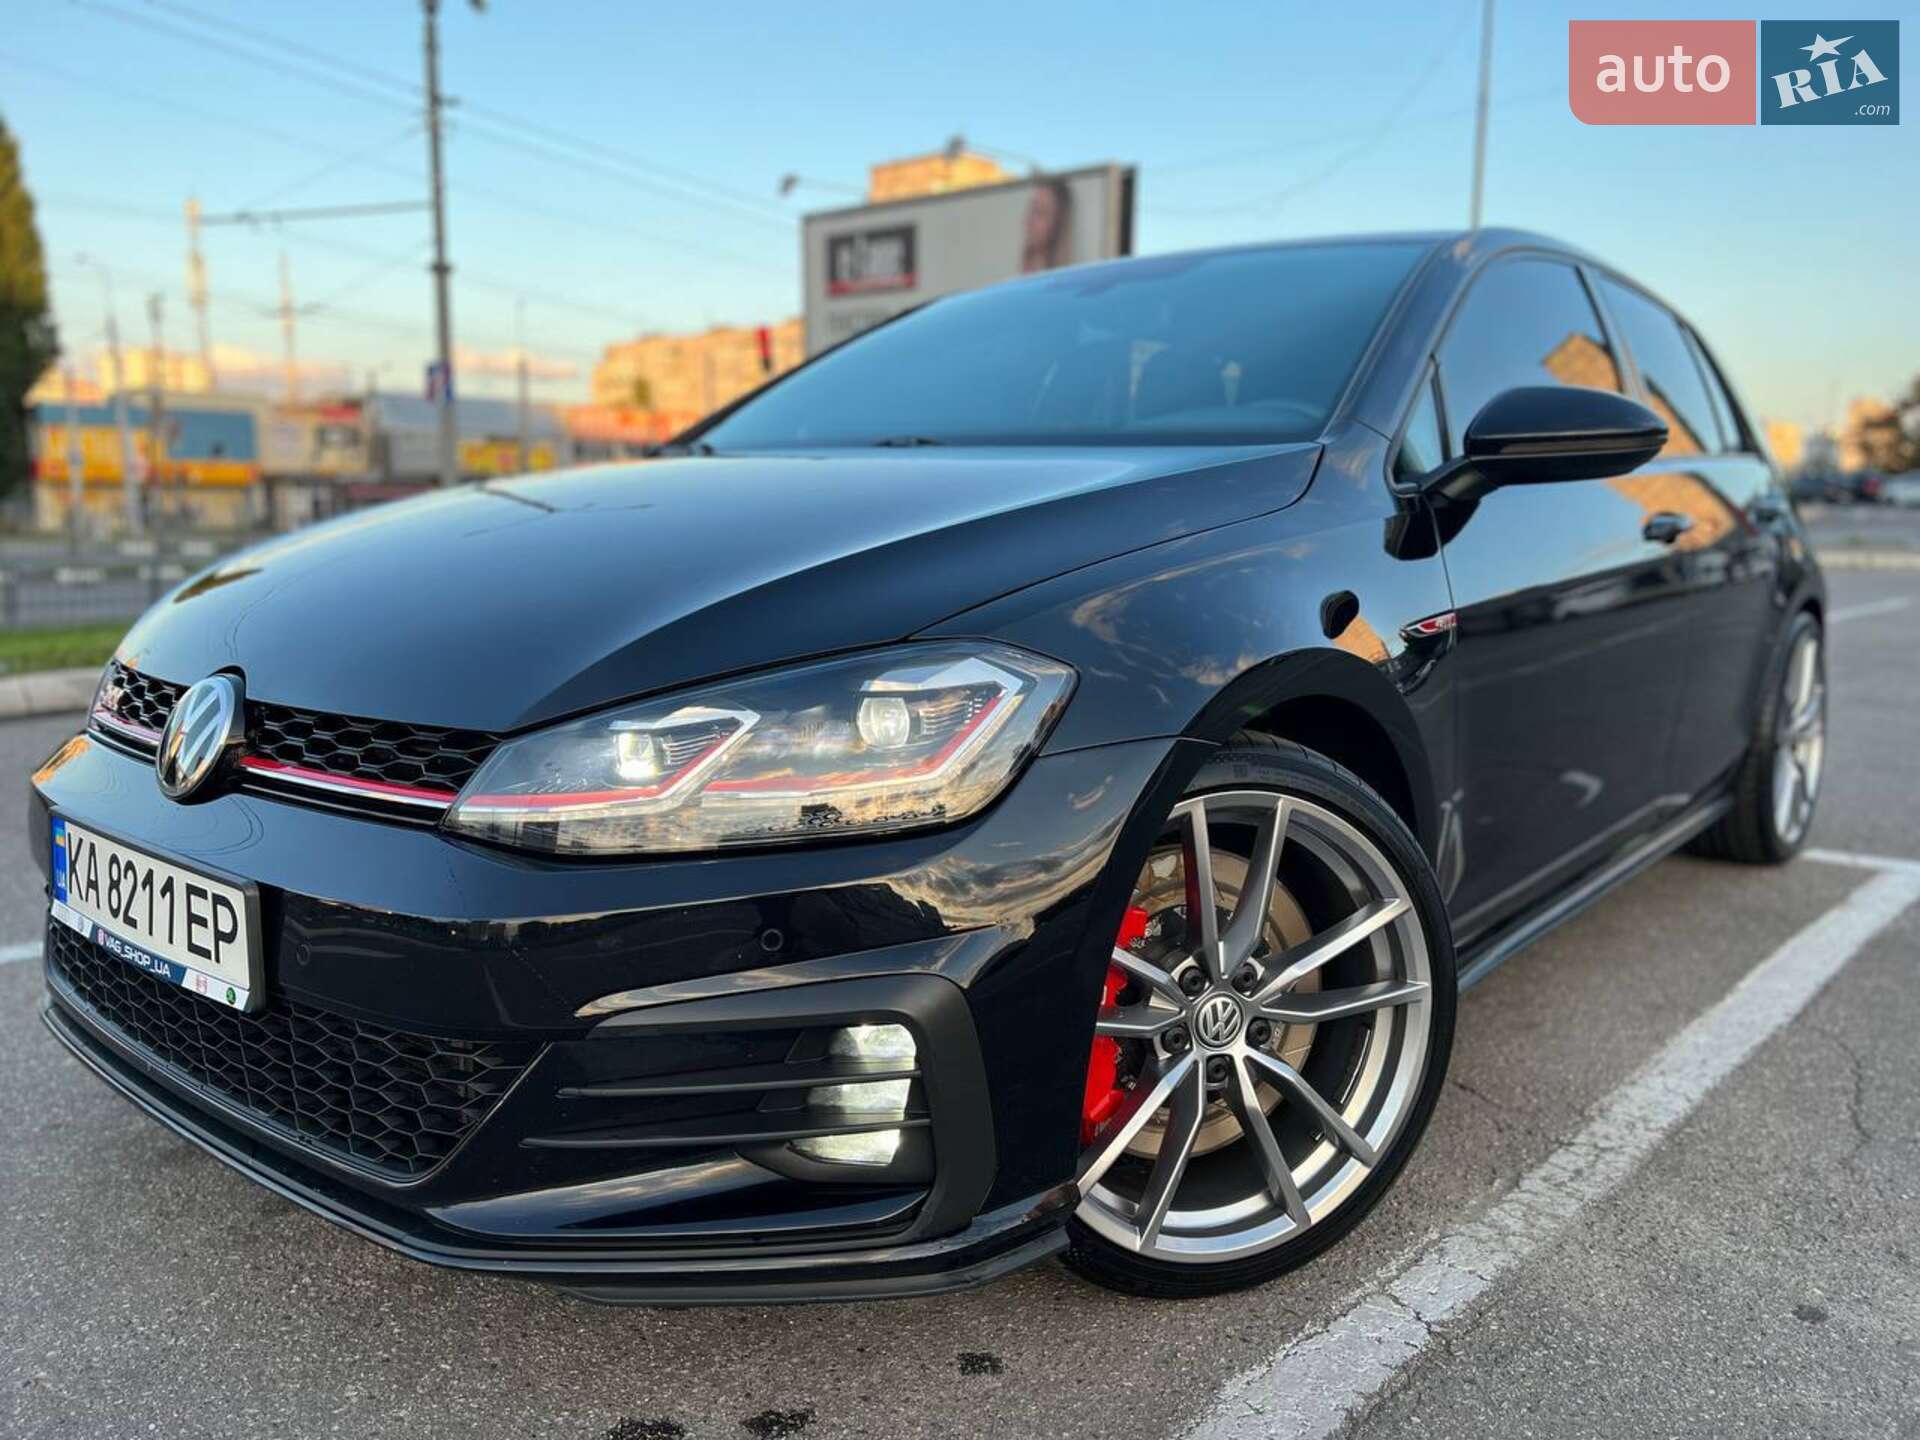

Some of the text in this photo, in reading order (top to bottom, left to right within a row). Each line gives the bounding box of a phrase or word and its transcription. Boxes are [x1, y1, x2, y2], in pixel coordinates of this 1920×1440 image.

[56, 868, 66, 888] UA
[68, 832, 238, 964] KA 8211 EP
